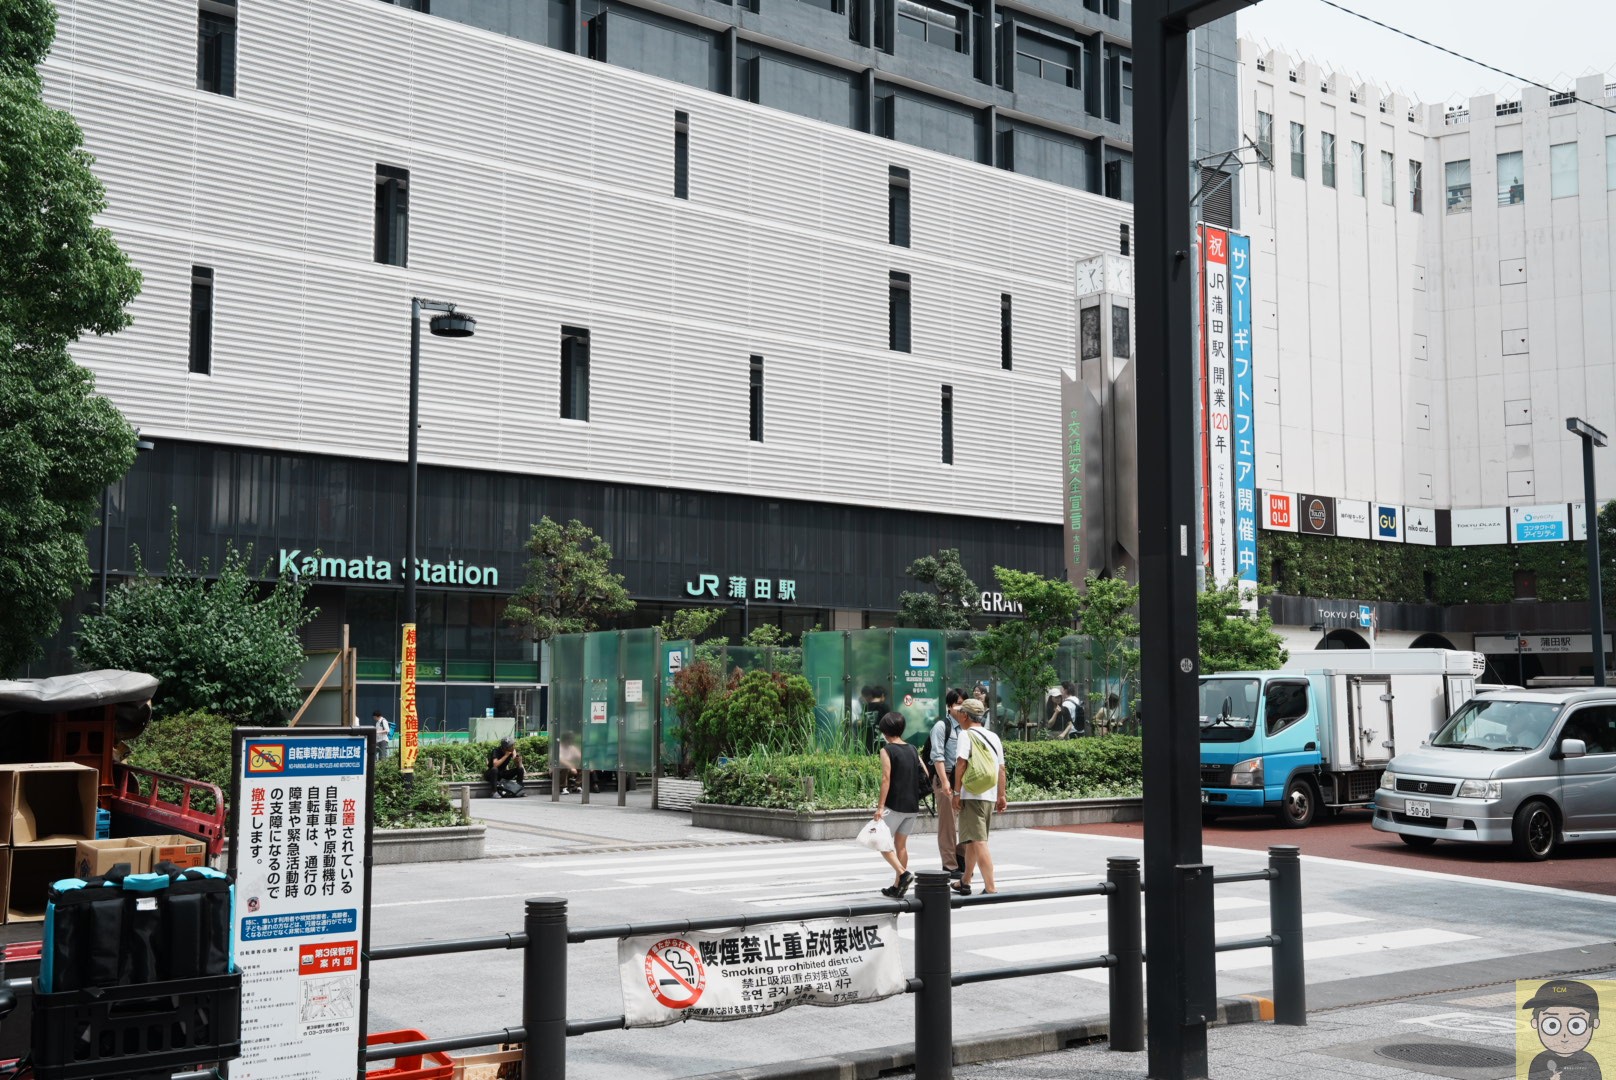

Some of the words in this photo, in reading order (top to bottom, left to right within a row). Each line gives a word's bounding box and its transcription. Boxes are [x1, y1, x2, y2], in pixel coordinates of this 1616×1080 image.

[1208, 234, 1224, 258] 祝
[1209, 272, 1229, 454] JR蒲田駅開業120年
[1232, 247, 1254, 570] サマーギフトフェア開催中
[1068, 420, 1083, 530] 交通安全宣言
[1271, 499, 1287, 511] UNI
[1272, 511, 1289, 525] QLO
[1379, 514, 1396, 530] GU
[1524, 530, 1556, 538] アイシティ
[279, 548, 392, 580] Kamata
[686, 573, 719, 597] JR
[728, 575, 796, 600] 蒲田駅
[1318, 609, 1347, 619] TOKYU
[1540, 637, 1571, 647] 蒲田駅
[288, 745, 361, 761] 自転車等放置禁止区域
[250, 787, 266, 865] 撤去します。
[267, 787, 284, 899] の支障になるので
[285, 786, 302, 898] 障害や緊急活動時
[304, 786, 320, 897] 自転車は、通行の
[322, 785, 338, 896] 自転車や原動機付
[341, 798, 356, 894] 放置されている
[315, 945, 354, 958] 第3保管所
[698, 924, 885, 968] 喫煙禁止重点対策地区
[721, 965, 774, 979] Smoking
[777, 959, 826, 974] prohibited
[828, 955, 864, 967] district
[741, 988, 763, 1001] 흡연
[768, 986, 788, 999] 금지
[816, 981, 832, 993] 관리
[835, 977, 852, 989] 지구
